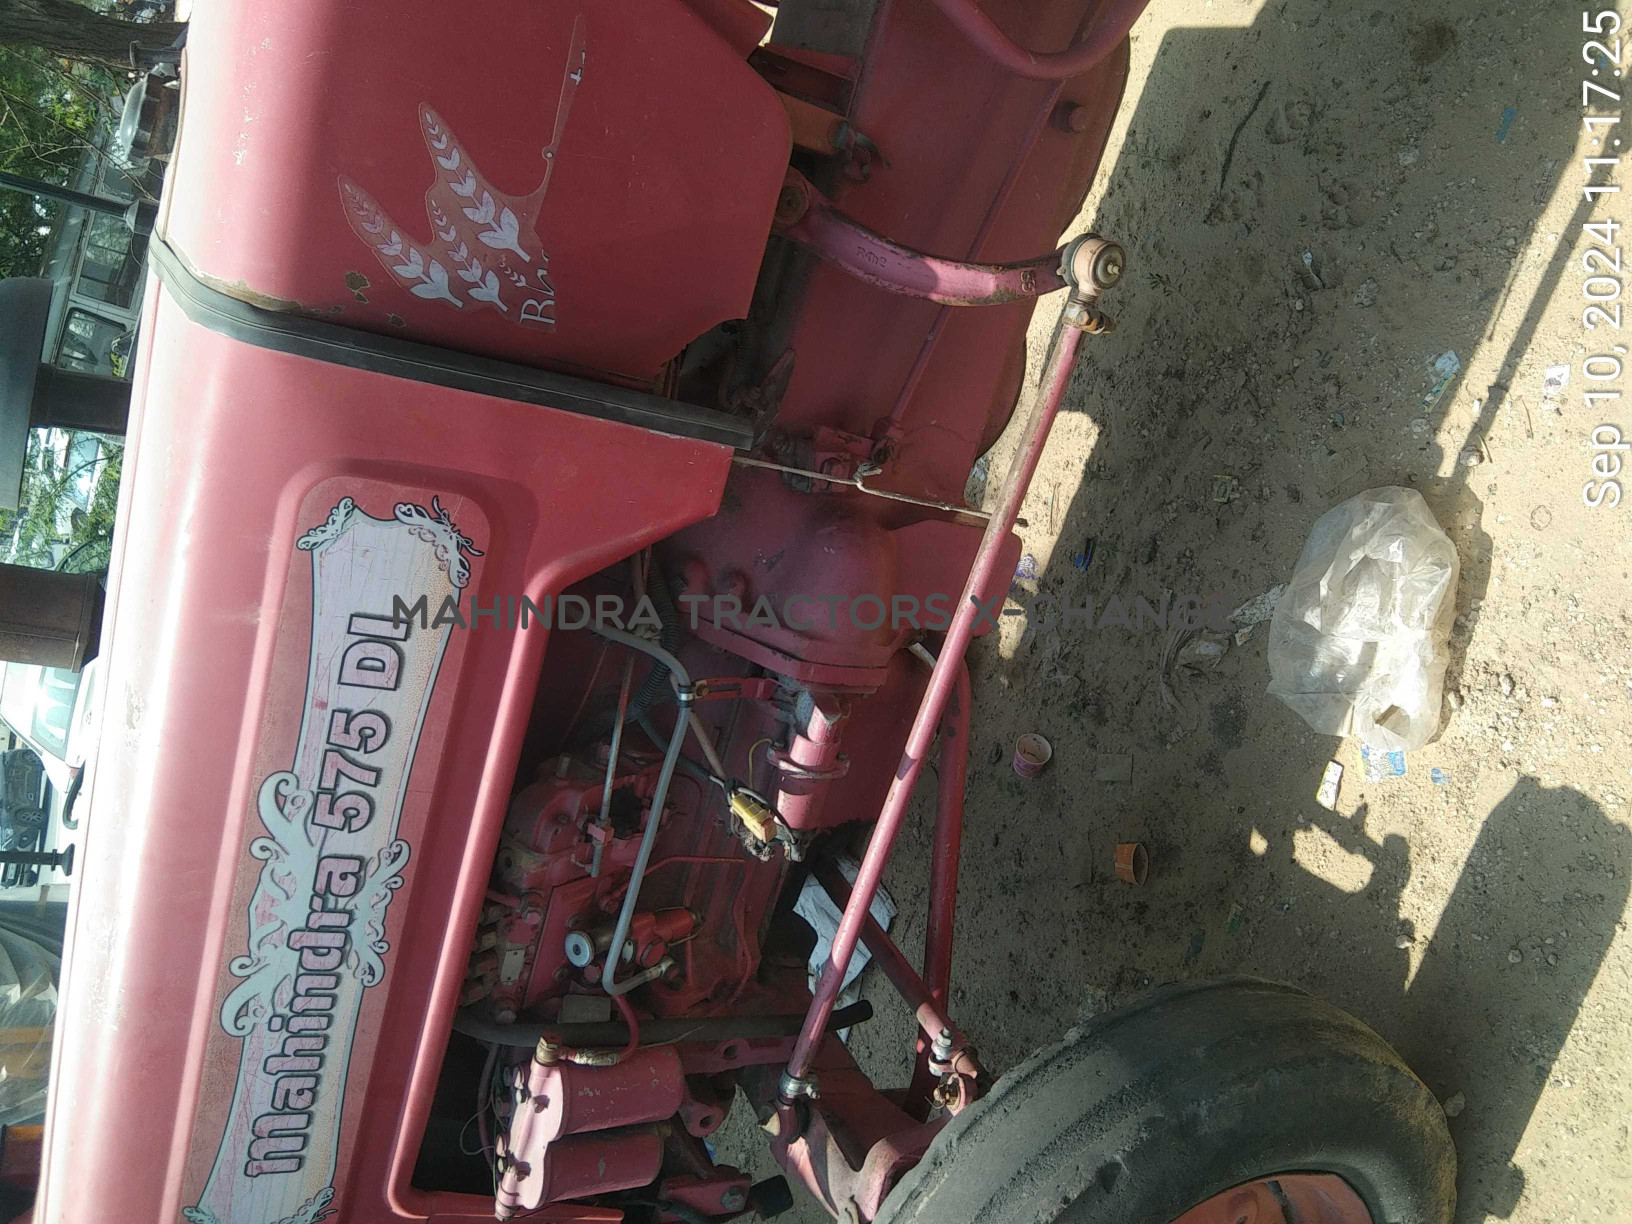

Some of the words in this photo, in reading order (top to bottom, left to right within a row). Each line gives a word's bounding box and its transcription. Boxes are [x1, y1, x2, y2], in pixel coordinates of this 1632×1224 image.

[337, 612, 412, 692] DI
[310, 709, 393, 834] 575
[243, 855, 364, 1178] Mahindra
